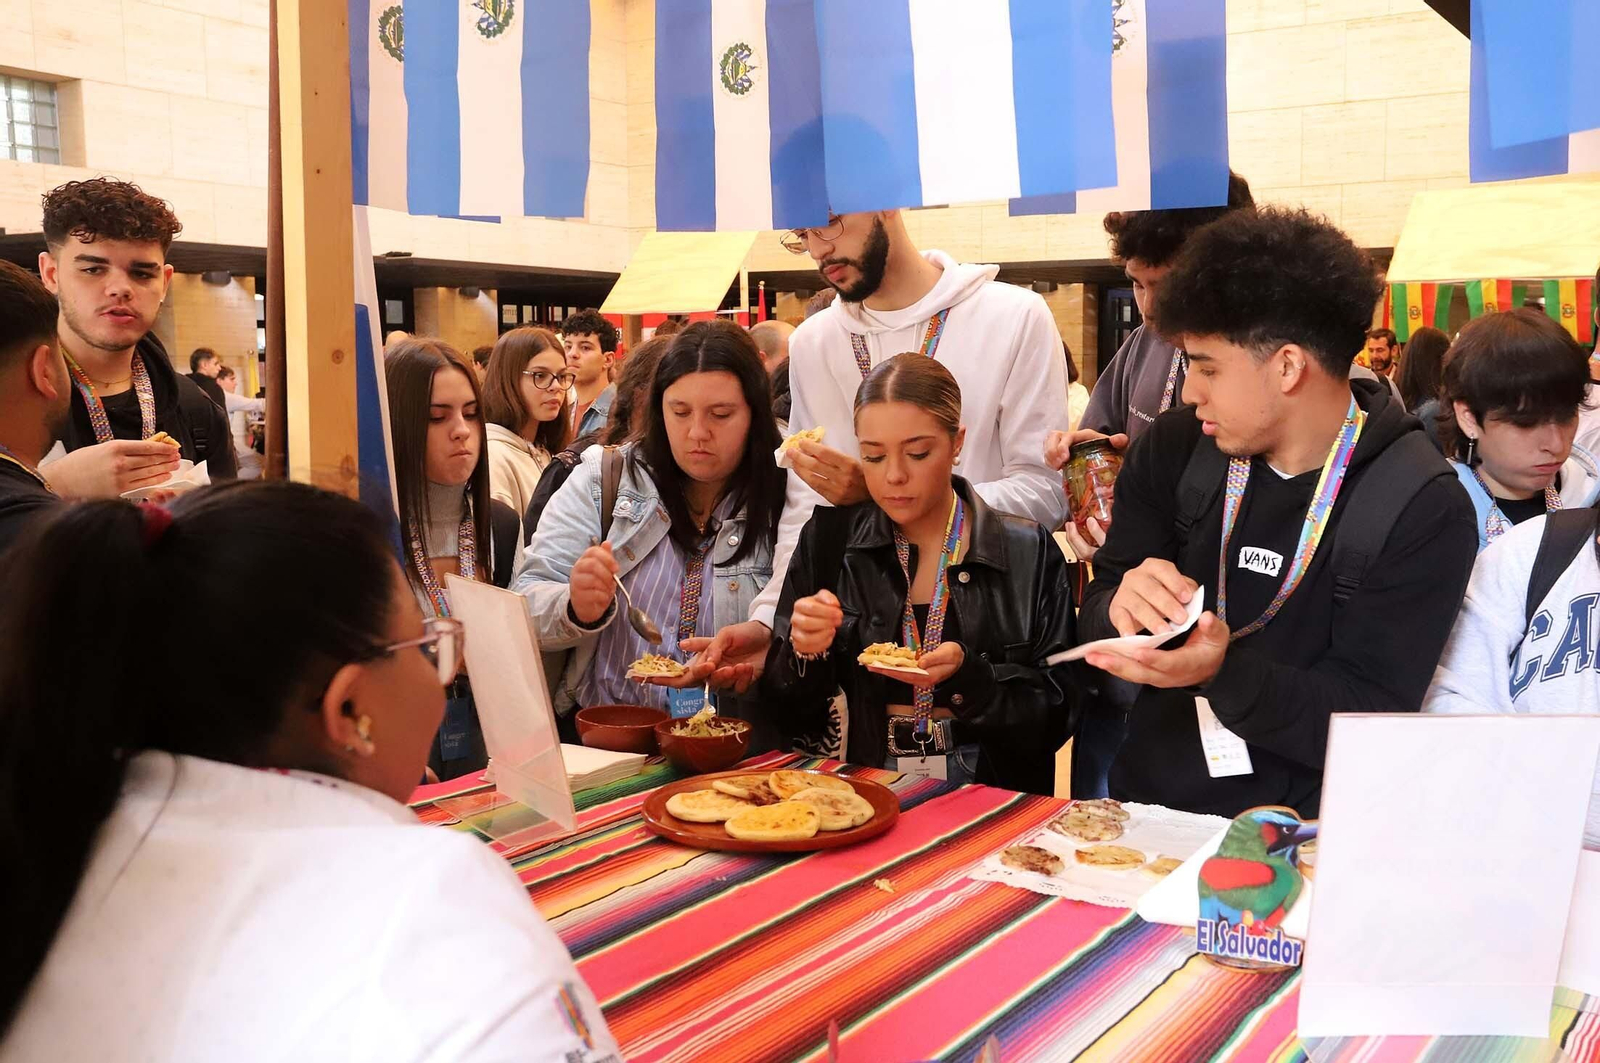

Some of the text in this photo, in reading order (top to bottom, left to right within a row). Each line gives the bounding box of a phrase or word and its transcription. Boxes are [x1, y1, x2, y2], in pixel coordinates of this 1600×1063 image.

[1244, 550, 1279, 571] VANS
[1508, 592, 1600, 704] CA
[675, 698, 705, 708] Congr
[1197, 919, 1301, 965] El Salvador
